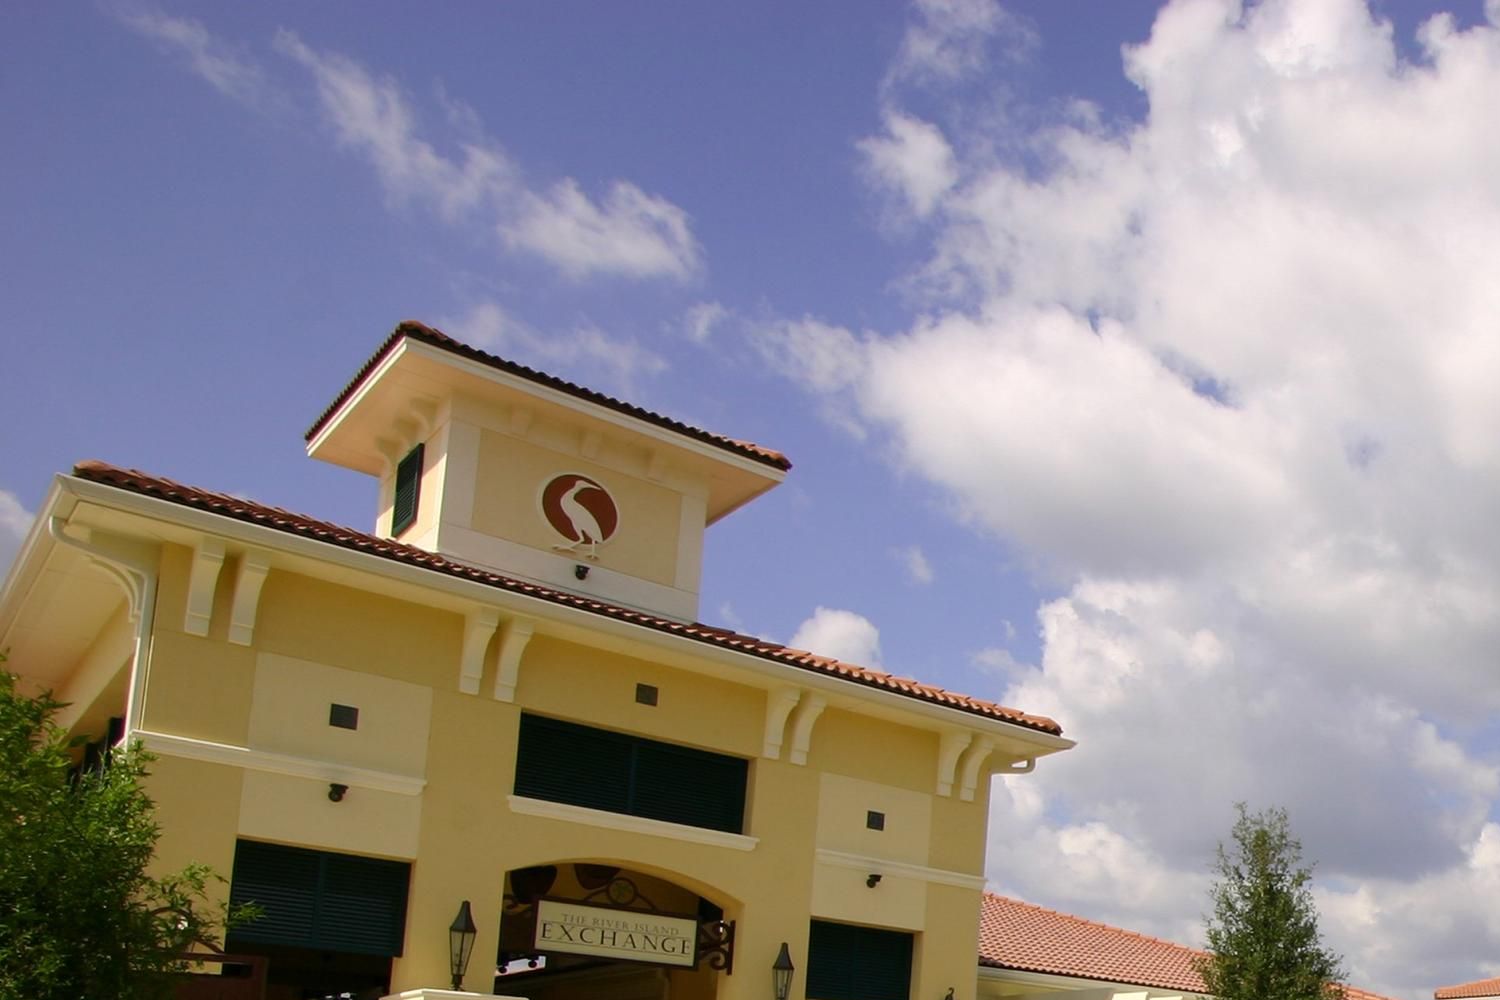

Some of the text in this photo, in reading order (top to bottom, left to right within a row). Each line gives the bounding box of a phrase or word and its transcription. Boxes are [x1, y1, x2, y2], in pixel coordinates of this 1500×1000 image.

[541, 922, 690, 955] EXCHANGE
[561, 913, 679, 936] THE RIVER ISLAND
